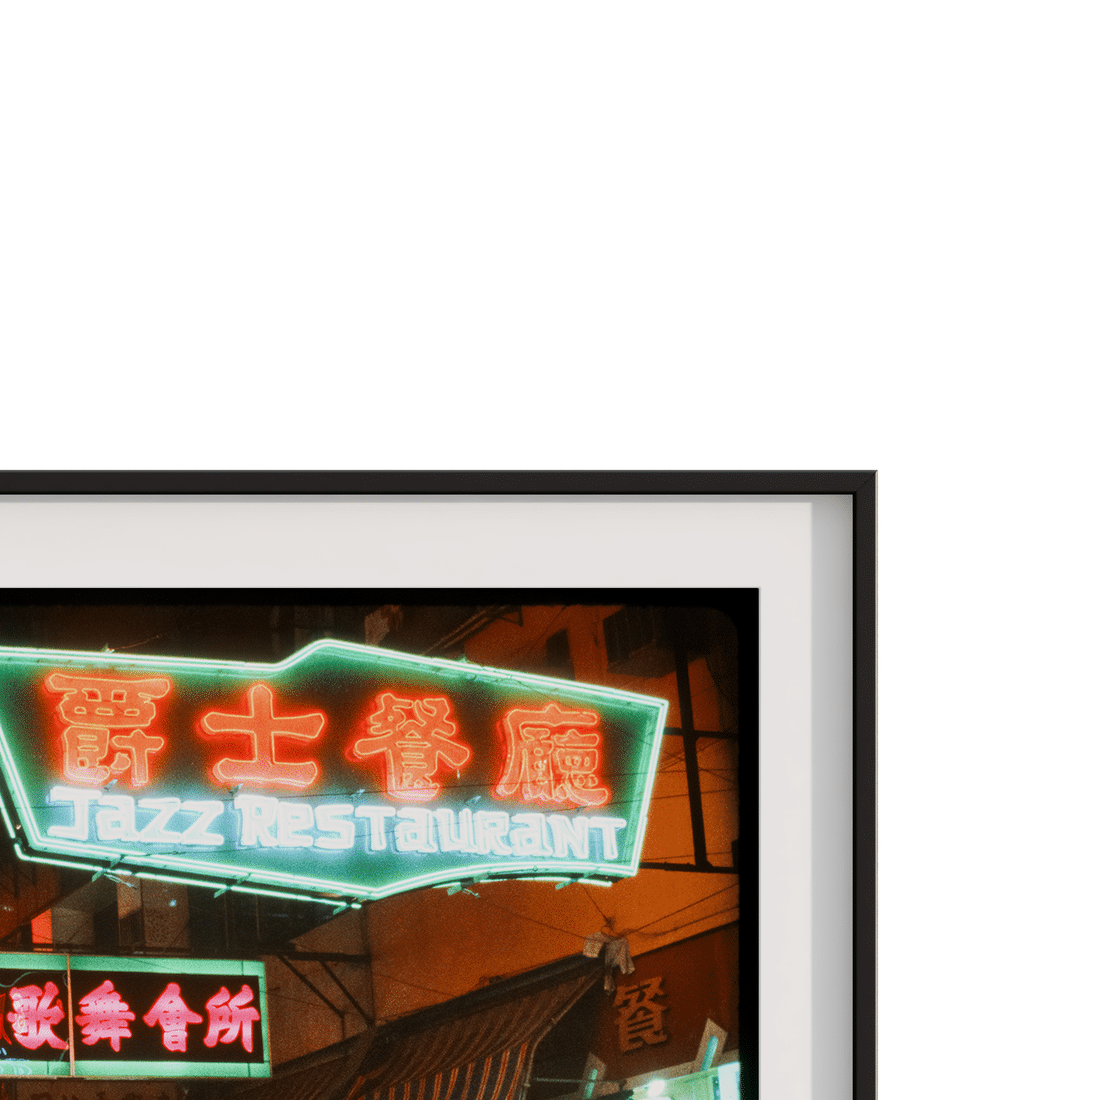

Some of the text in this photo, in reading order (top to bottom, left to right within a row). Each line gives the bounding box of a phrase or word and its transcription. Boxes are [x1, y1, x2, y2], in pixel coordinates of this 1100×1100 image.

[44, 671, 609, 806] 爵士餐廳
[47, 785, 226, 846] Jazz
[613, 976, 668, 1052] 餐
